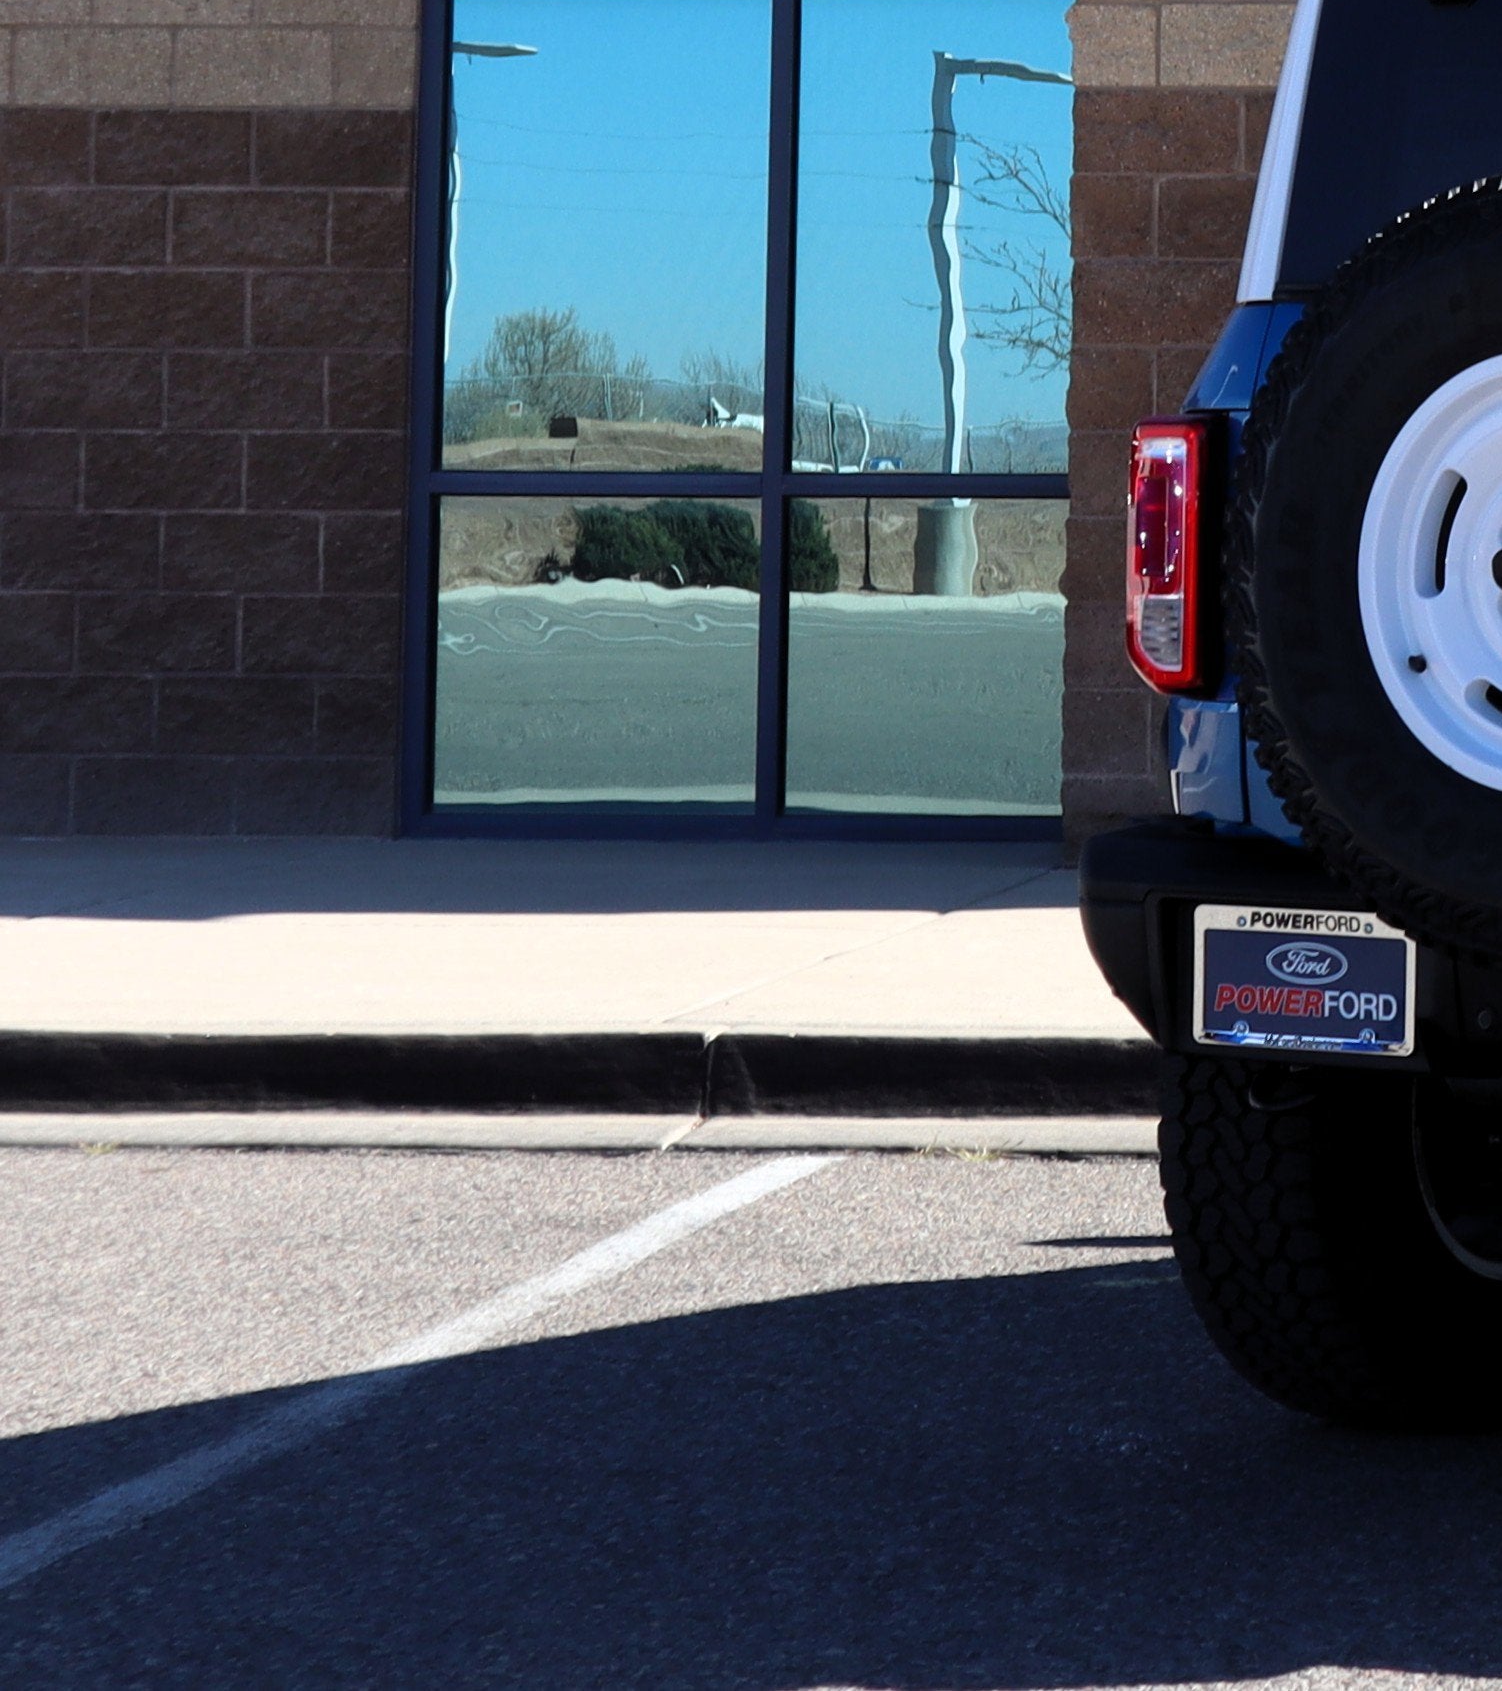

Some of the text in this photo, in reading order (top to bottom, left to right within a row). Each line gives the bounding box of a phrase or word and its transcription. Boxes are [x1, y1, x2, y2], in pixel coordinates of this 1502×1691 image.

[1250, 911, 1361, 933] POWERFORD
[1281, 949, 1333, 976] Ford
[1214, 983, 1398, 1021] POWERFORD
